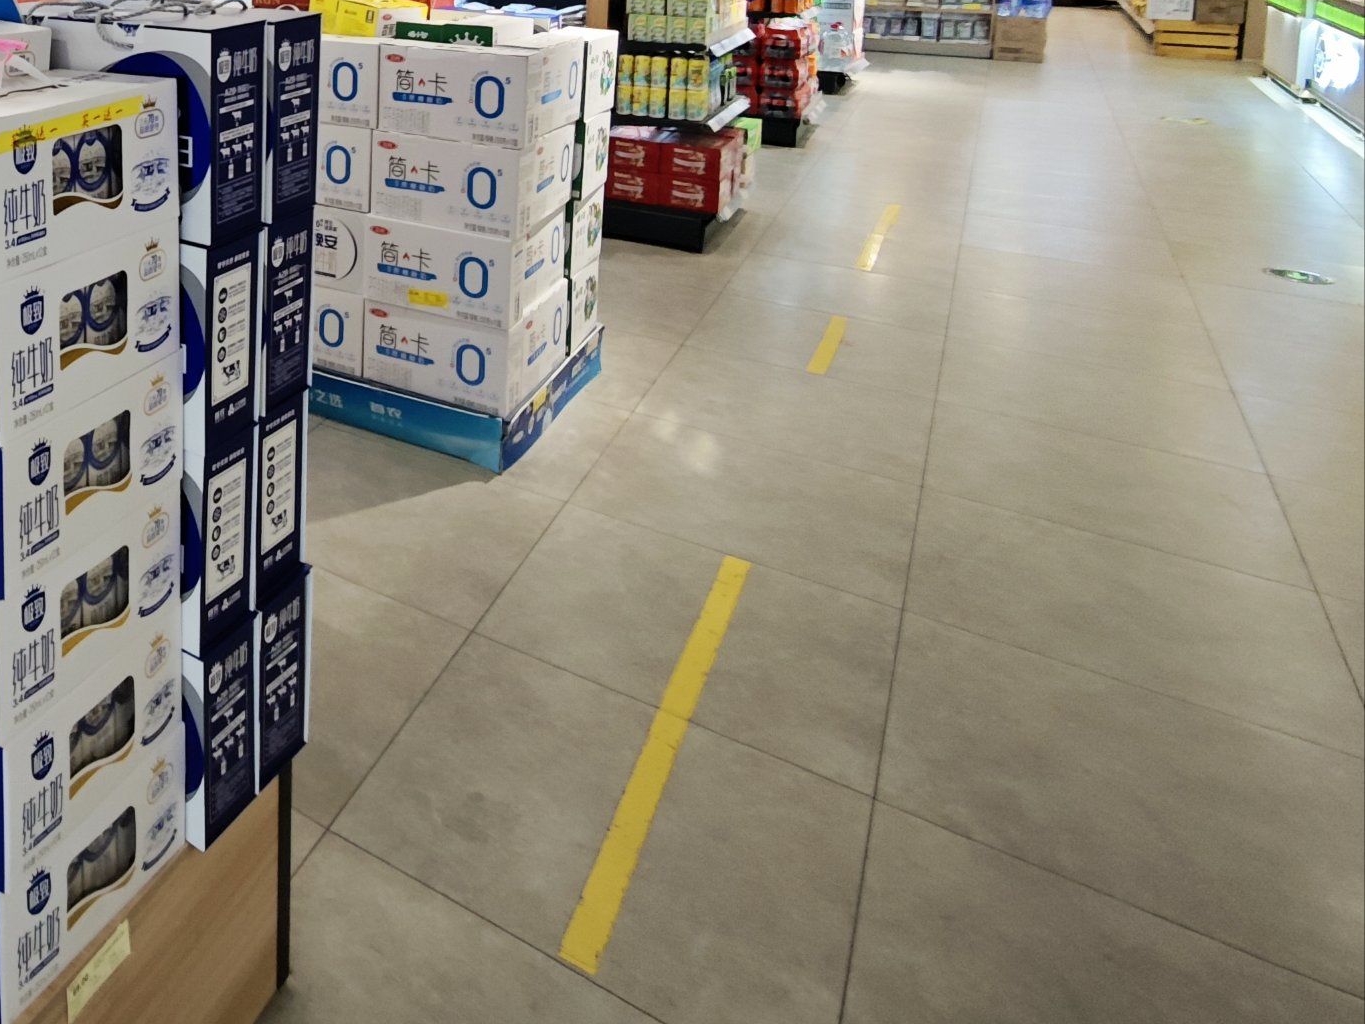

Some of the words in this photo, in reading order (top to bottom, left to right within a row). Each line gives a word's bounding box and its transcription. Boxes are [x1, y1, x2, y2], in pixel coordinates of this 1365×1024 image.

[4, 178, 47, 237] 纯牛奶
[11, 336, 55, 398] 纯牛奶
[19, 484, 60, 549] 纯牛奶
[12, 627, 56, 697] 纯牛奶
[22, 772, 63, 849] 纯牛奶
[17, 905, 61, 980] 纯牛奶
